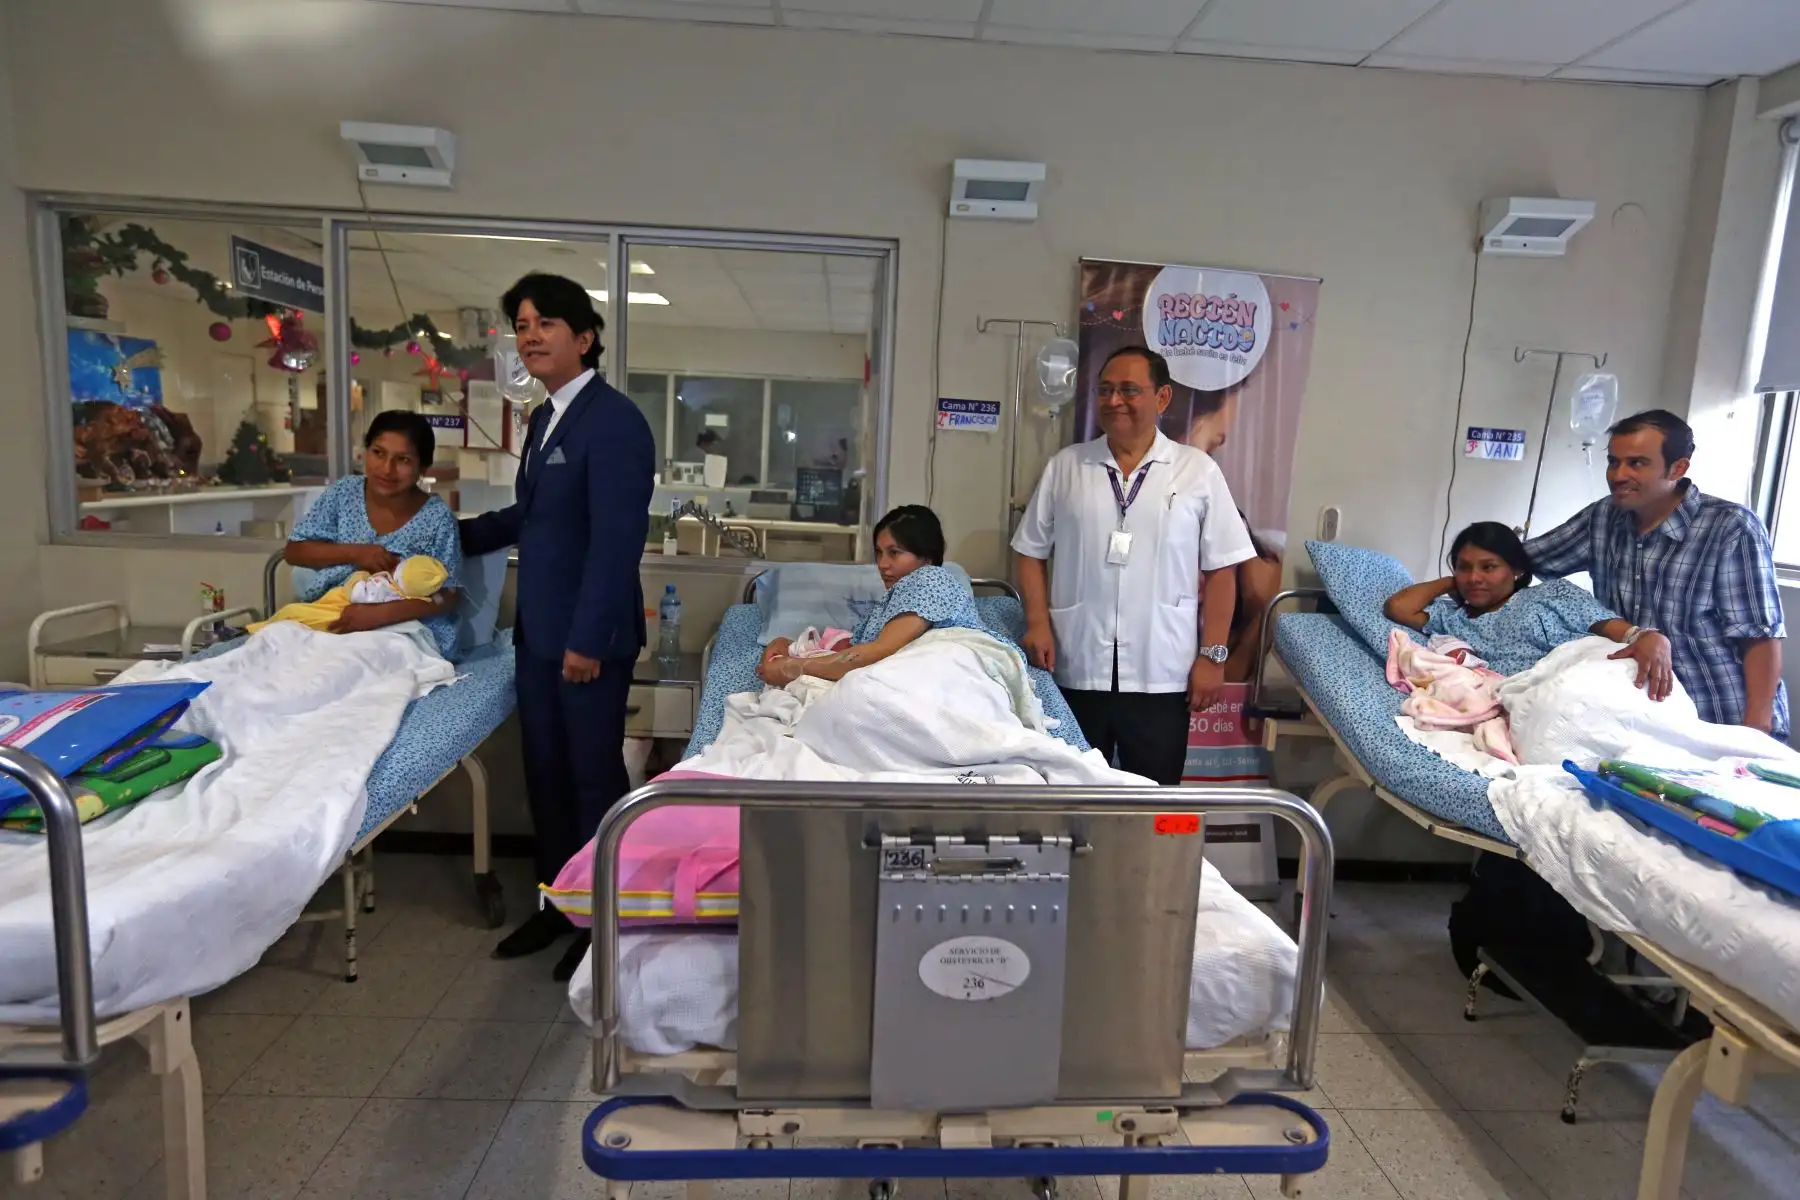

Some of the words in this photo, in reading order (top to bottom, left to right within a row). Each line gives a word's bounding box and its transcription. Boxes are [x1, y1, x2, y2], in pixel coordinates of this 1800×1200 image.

[261, 265, 295, 287] Estación
[1157, 293, 1257, 328] RECIÉN
[942, 401, 966, 411] Cama
[980, 403, 997, 412] 236
[444, 417, 461, 426] 237
[1471, 430, 1494, 440] Cama
[1484, 442, 1519, 458] VANI
[1189, 717, 1209, 733] 30
[889, 850, 921, 867] 236
[963, 976, 986, 989] 236
